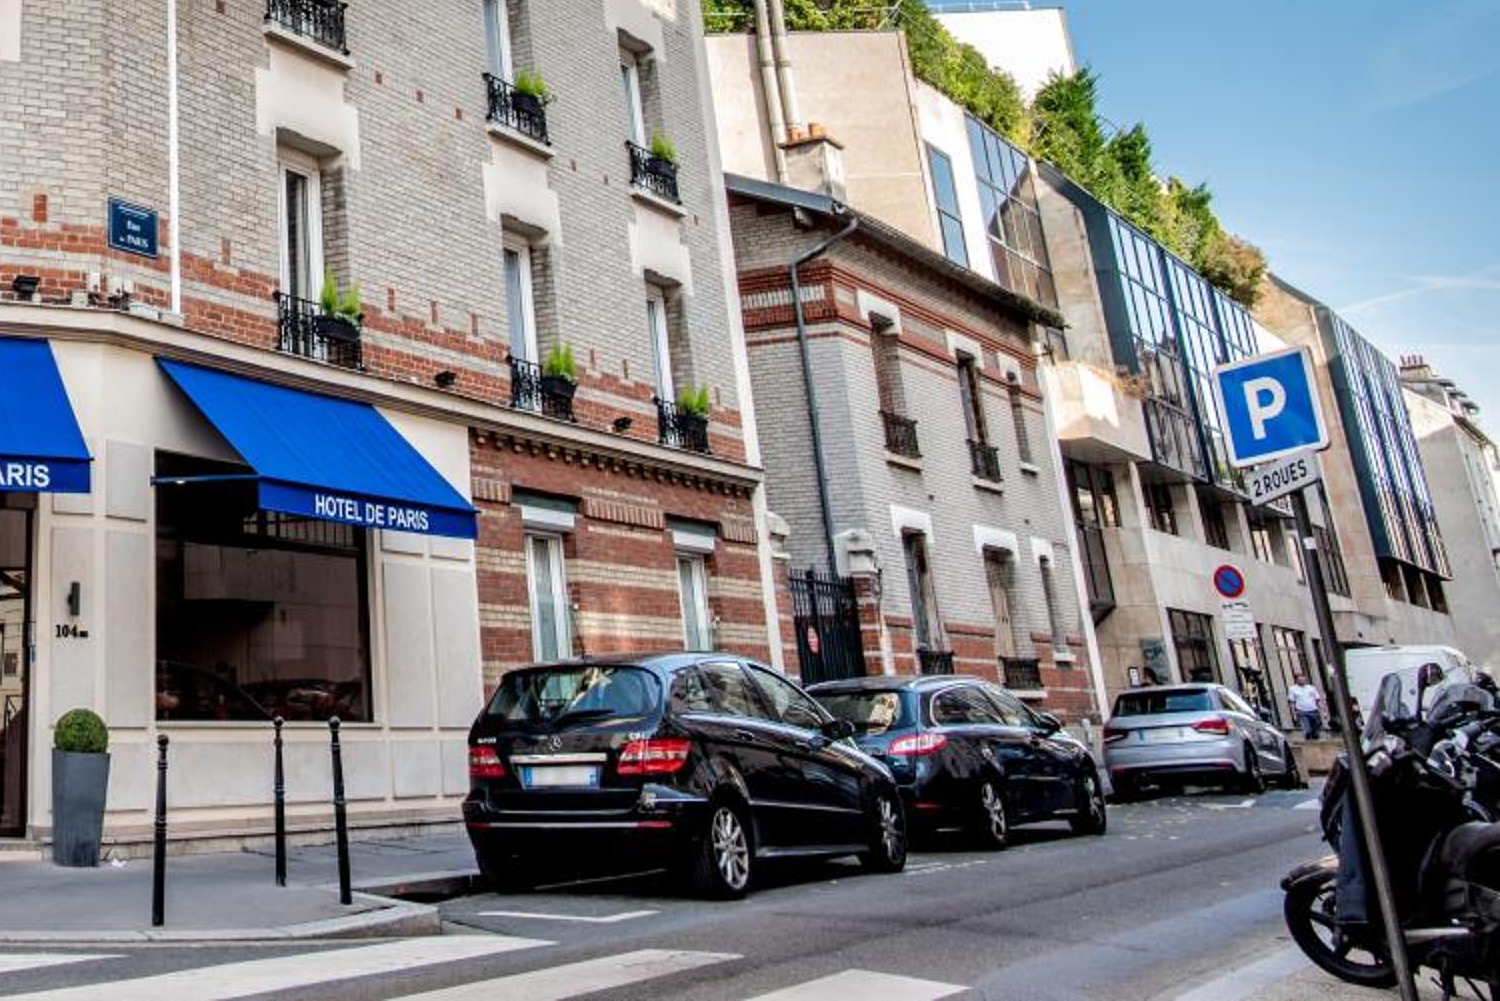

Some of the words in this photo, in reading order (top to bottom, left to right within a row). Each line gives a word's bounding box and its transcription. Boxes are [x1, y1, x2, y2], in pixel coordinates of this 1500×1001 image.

[1243, 376, 1287, 440] P
[1263, 459, 1308, 494] ROUES
[315, 493, 363, 522] HOTEL
[366, 503, 385, 525] DE
[388, 506, 430, 531] PARIS
